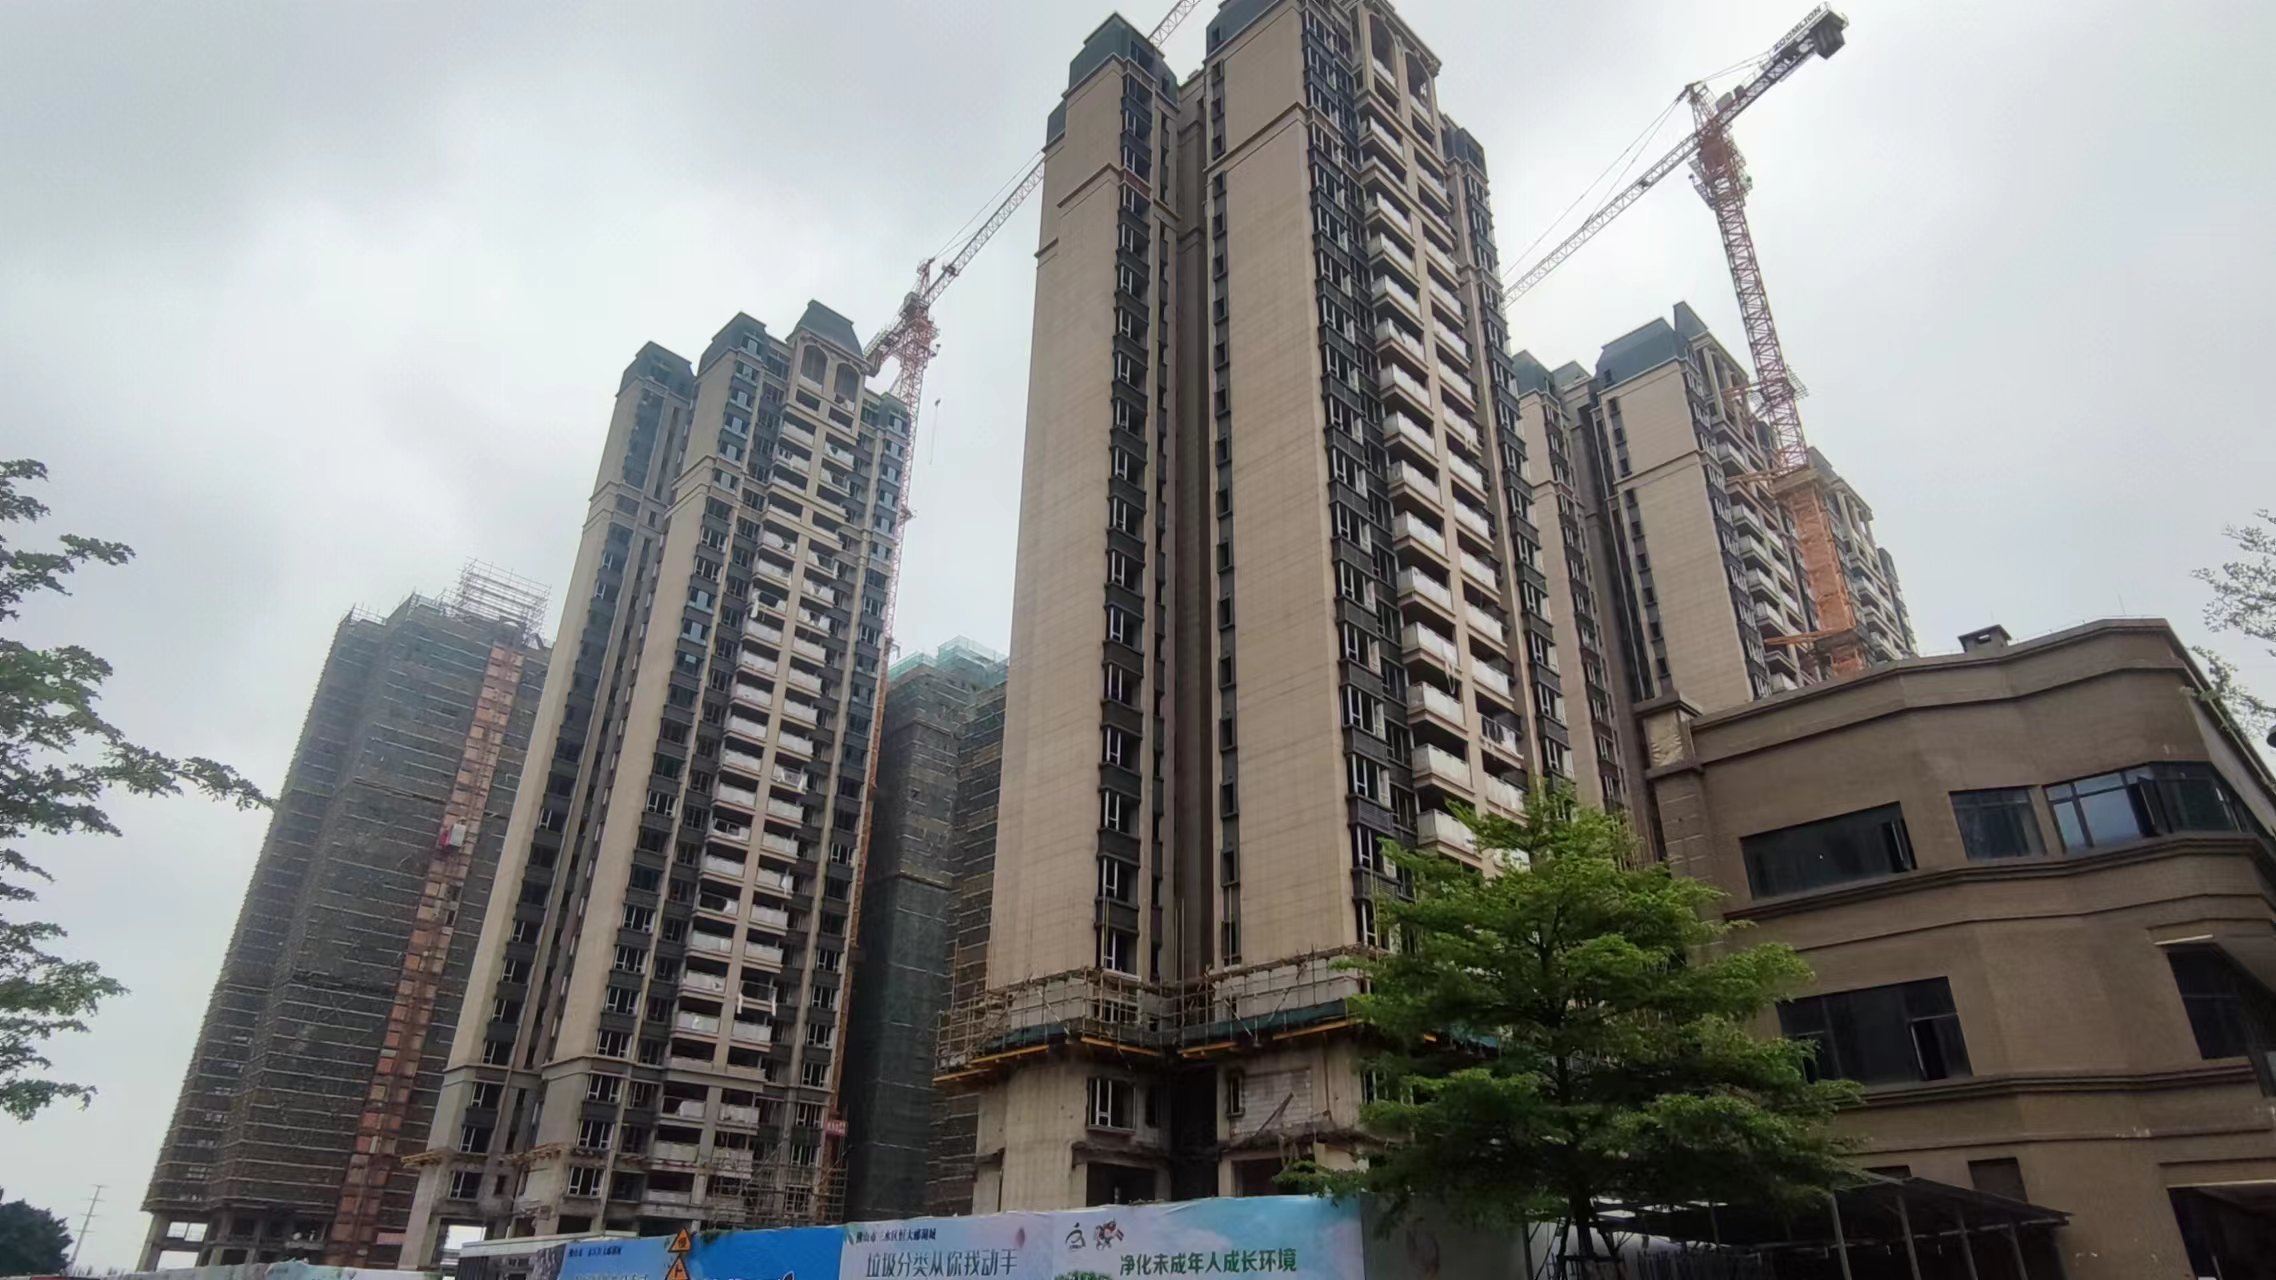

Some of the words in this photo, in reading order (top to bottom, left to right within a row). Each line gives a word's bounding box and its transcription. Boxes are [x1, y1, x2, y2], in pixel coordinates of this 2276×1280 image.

[1773, 5, 1822, 52] ZOOMLION
[866, 1249, 1017, 1277] 垃圾分类从你我动手
[1120, 1248, 1297, 1276] 净化未成年人成长环境
